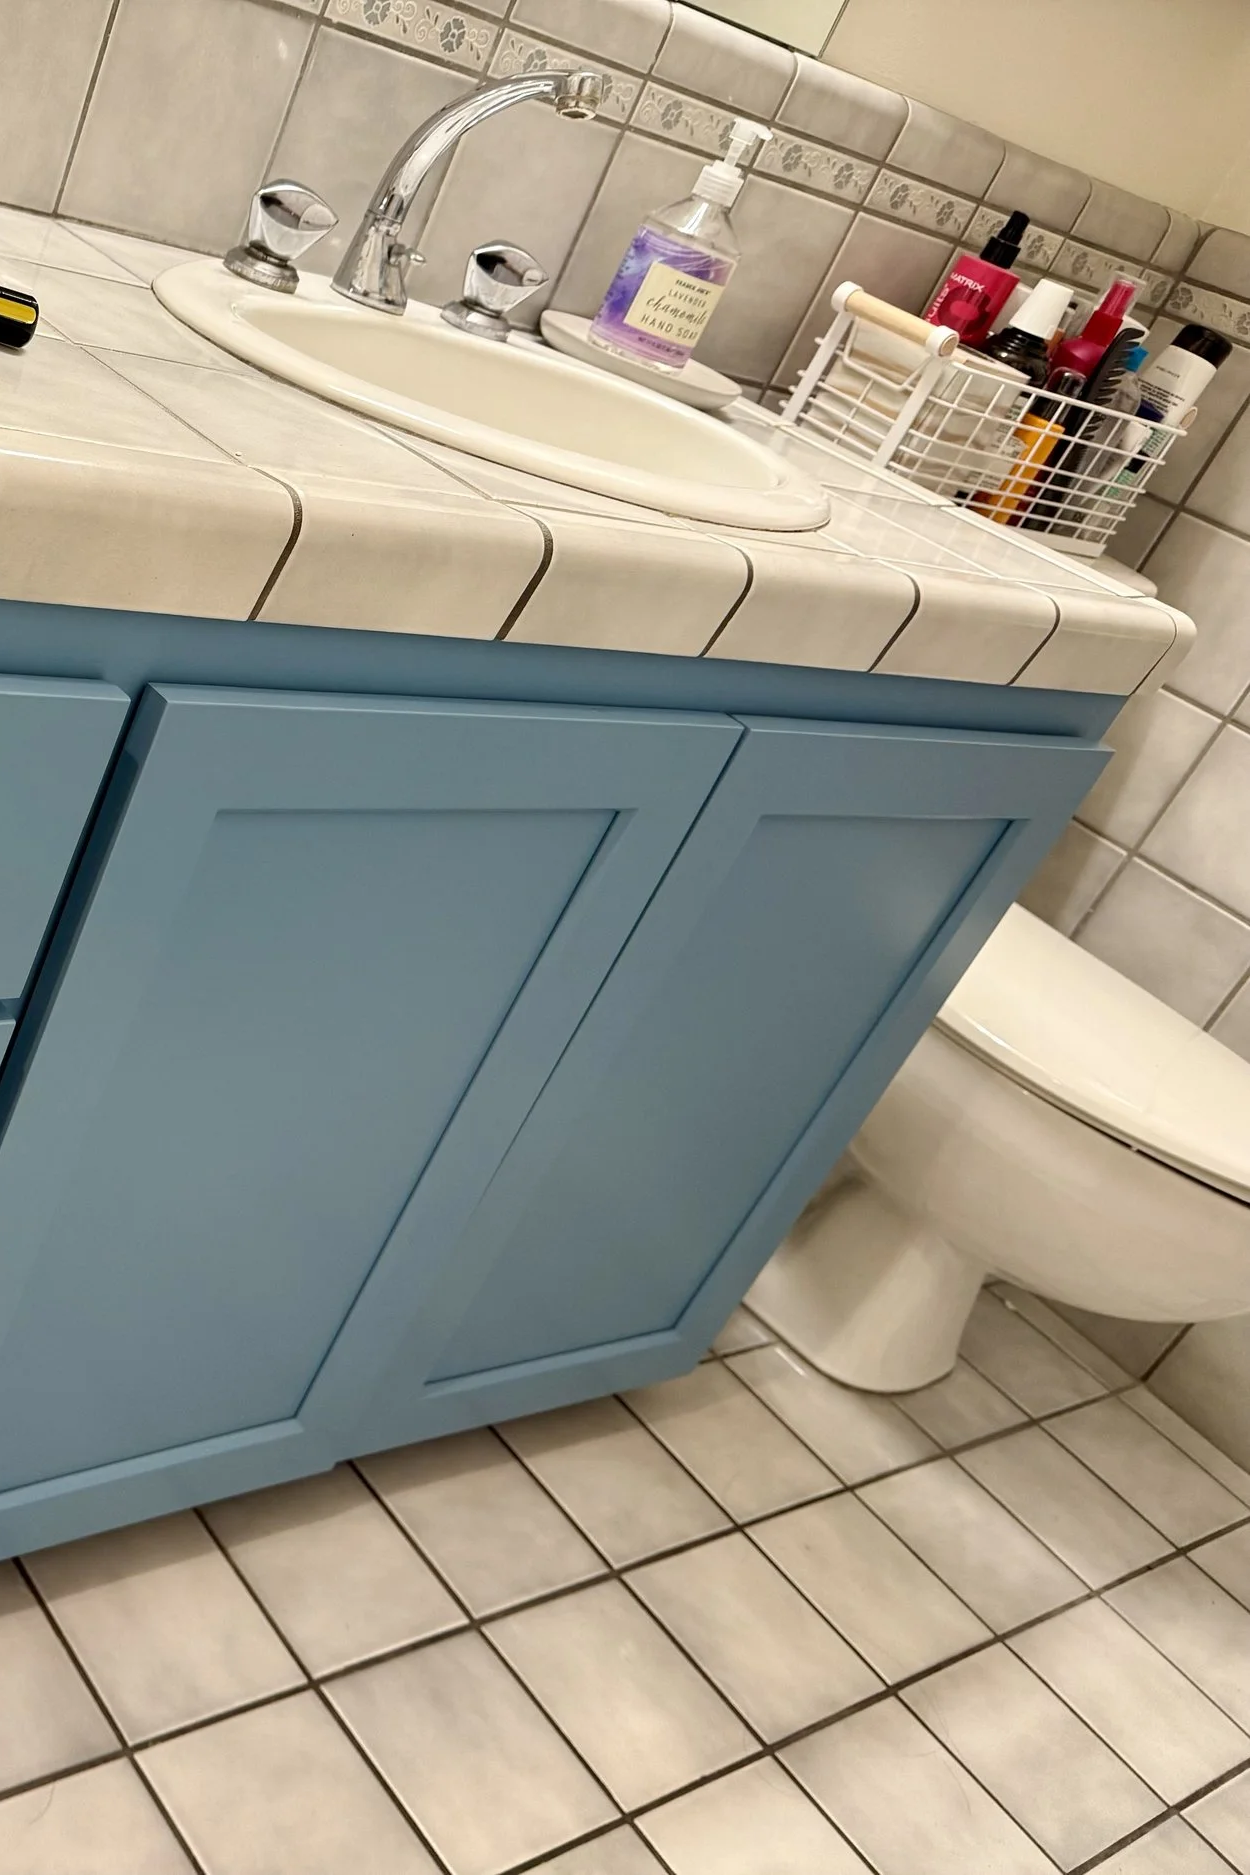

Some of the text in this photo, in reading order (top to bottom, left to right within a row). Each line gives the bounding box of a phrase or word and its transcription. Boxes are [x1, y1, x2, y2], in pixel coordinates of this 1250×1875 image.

[950, 272, 985, 293] MATRIX
[668, 289, 707, 308] LAVENDER
[640, 313, 698, 340] HAND SOAP
